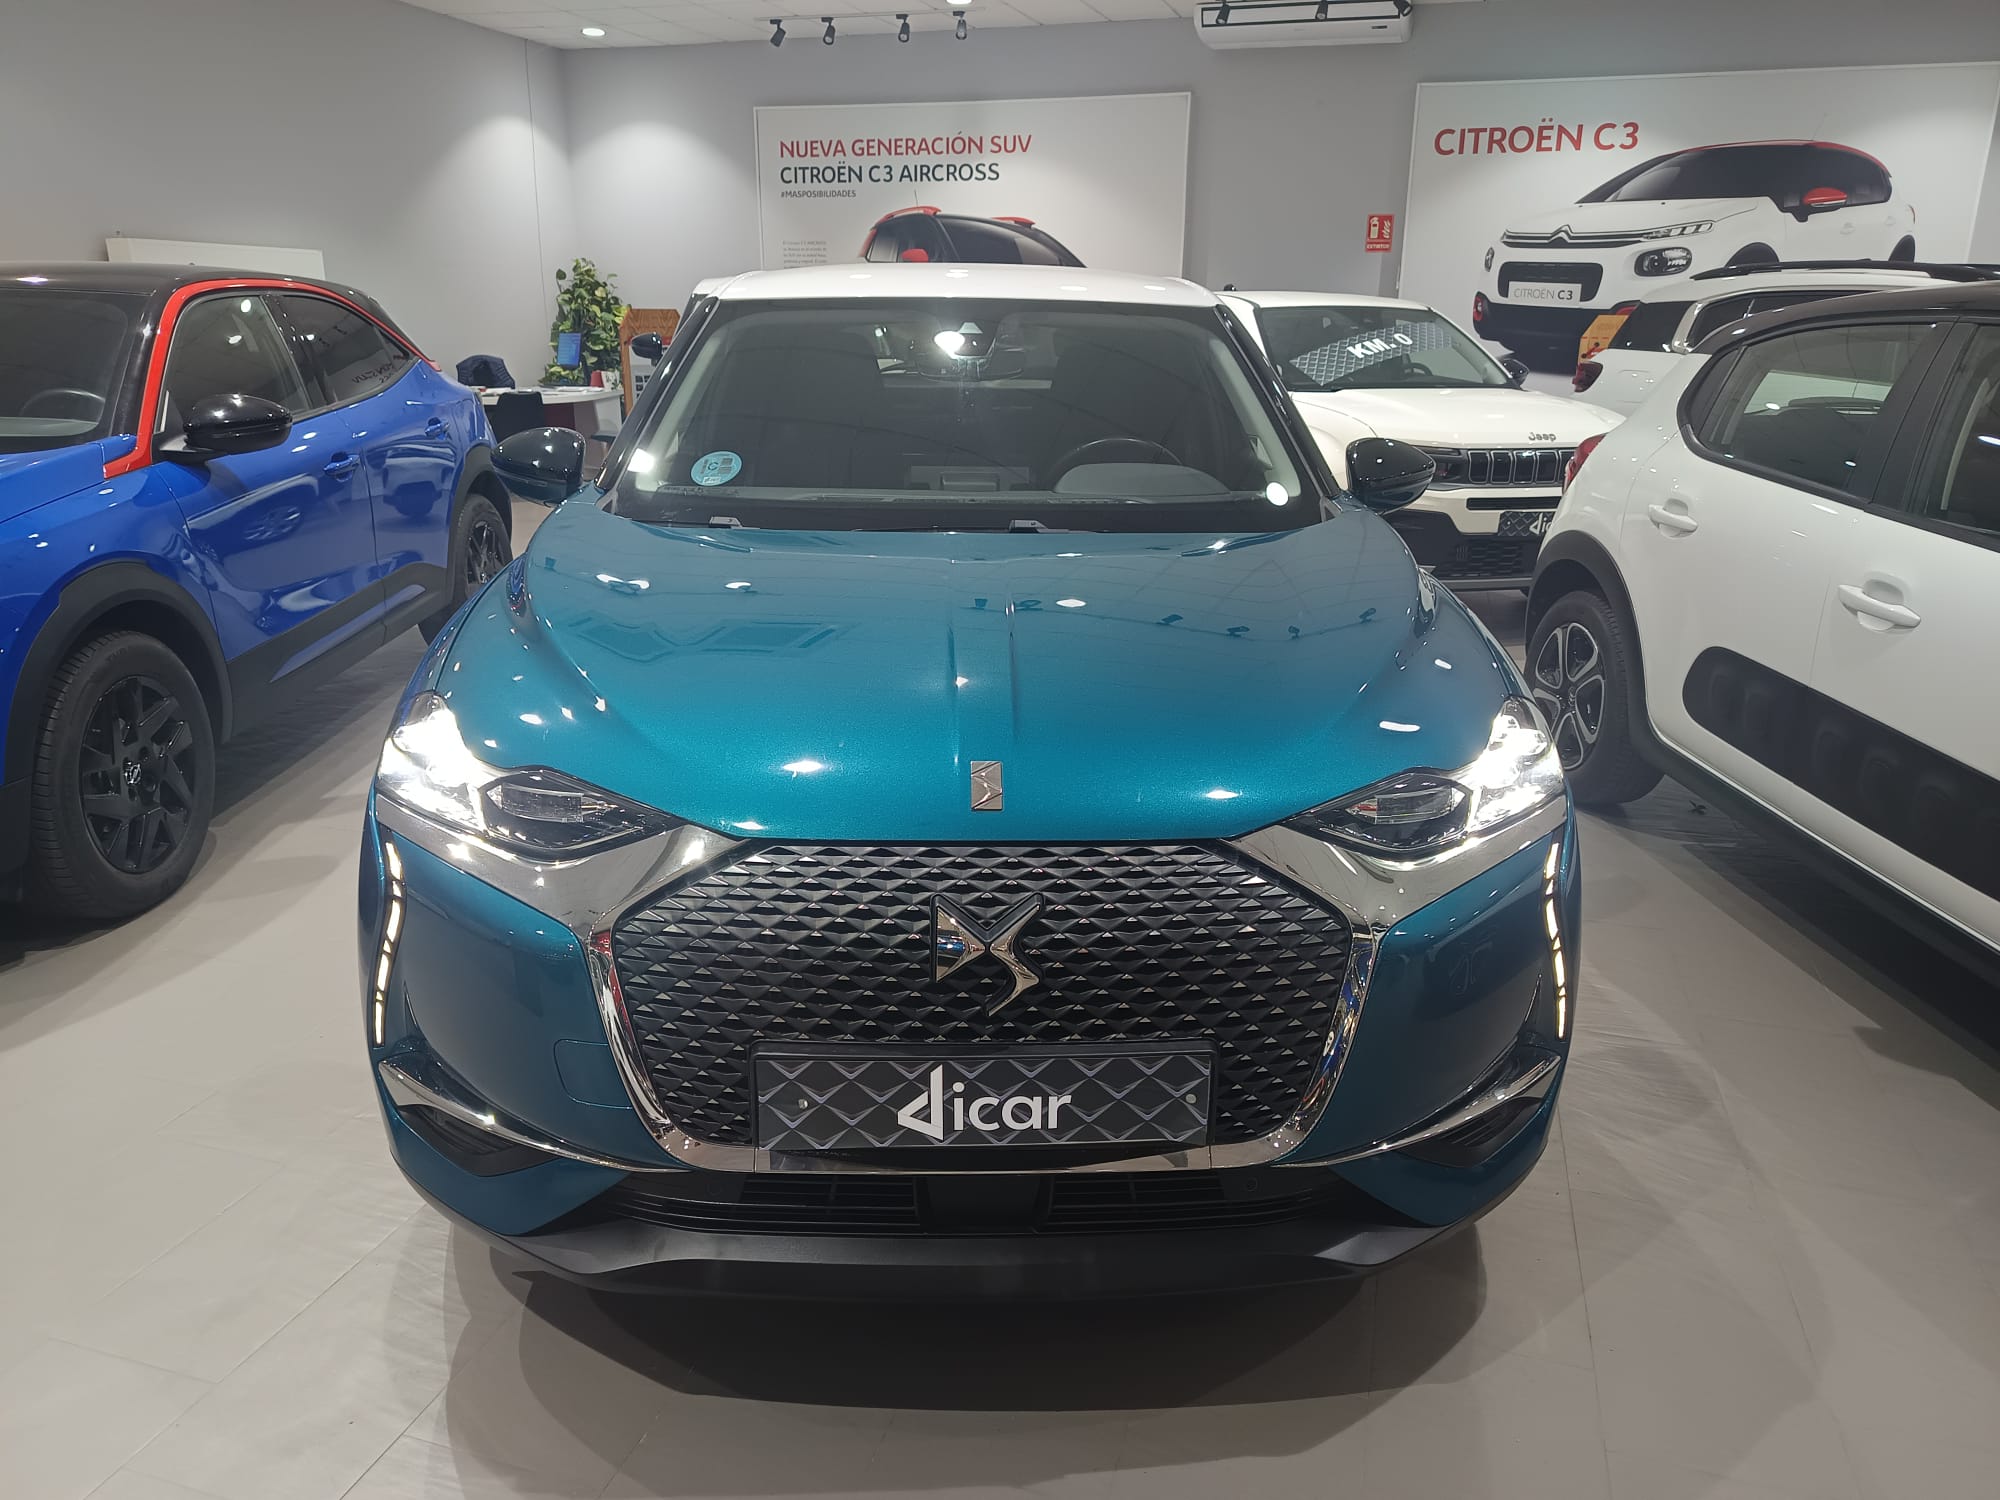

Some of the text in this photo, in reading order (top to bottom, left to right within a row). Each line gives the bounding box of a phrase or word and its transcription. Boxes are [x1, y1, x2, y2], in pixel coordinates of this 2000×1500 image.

[780, 130, 1032, 158] NUEVA GENERACIÓN SUV
[1434, 117, 1640, 156] CITROËN C3
[780, 160, 1000, 184] CITROËN C3 AIRCROSS
[780, 189, 857, 198] #MASPOSIBILIDADES
[1557, 289, 1573, 300] C3
[1528, 431, 1557, 442] Jeep
[1529, 512, 1552, 534] dic
